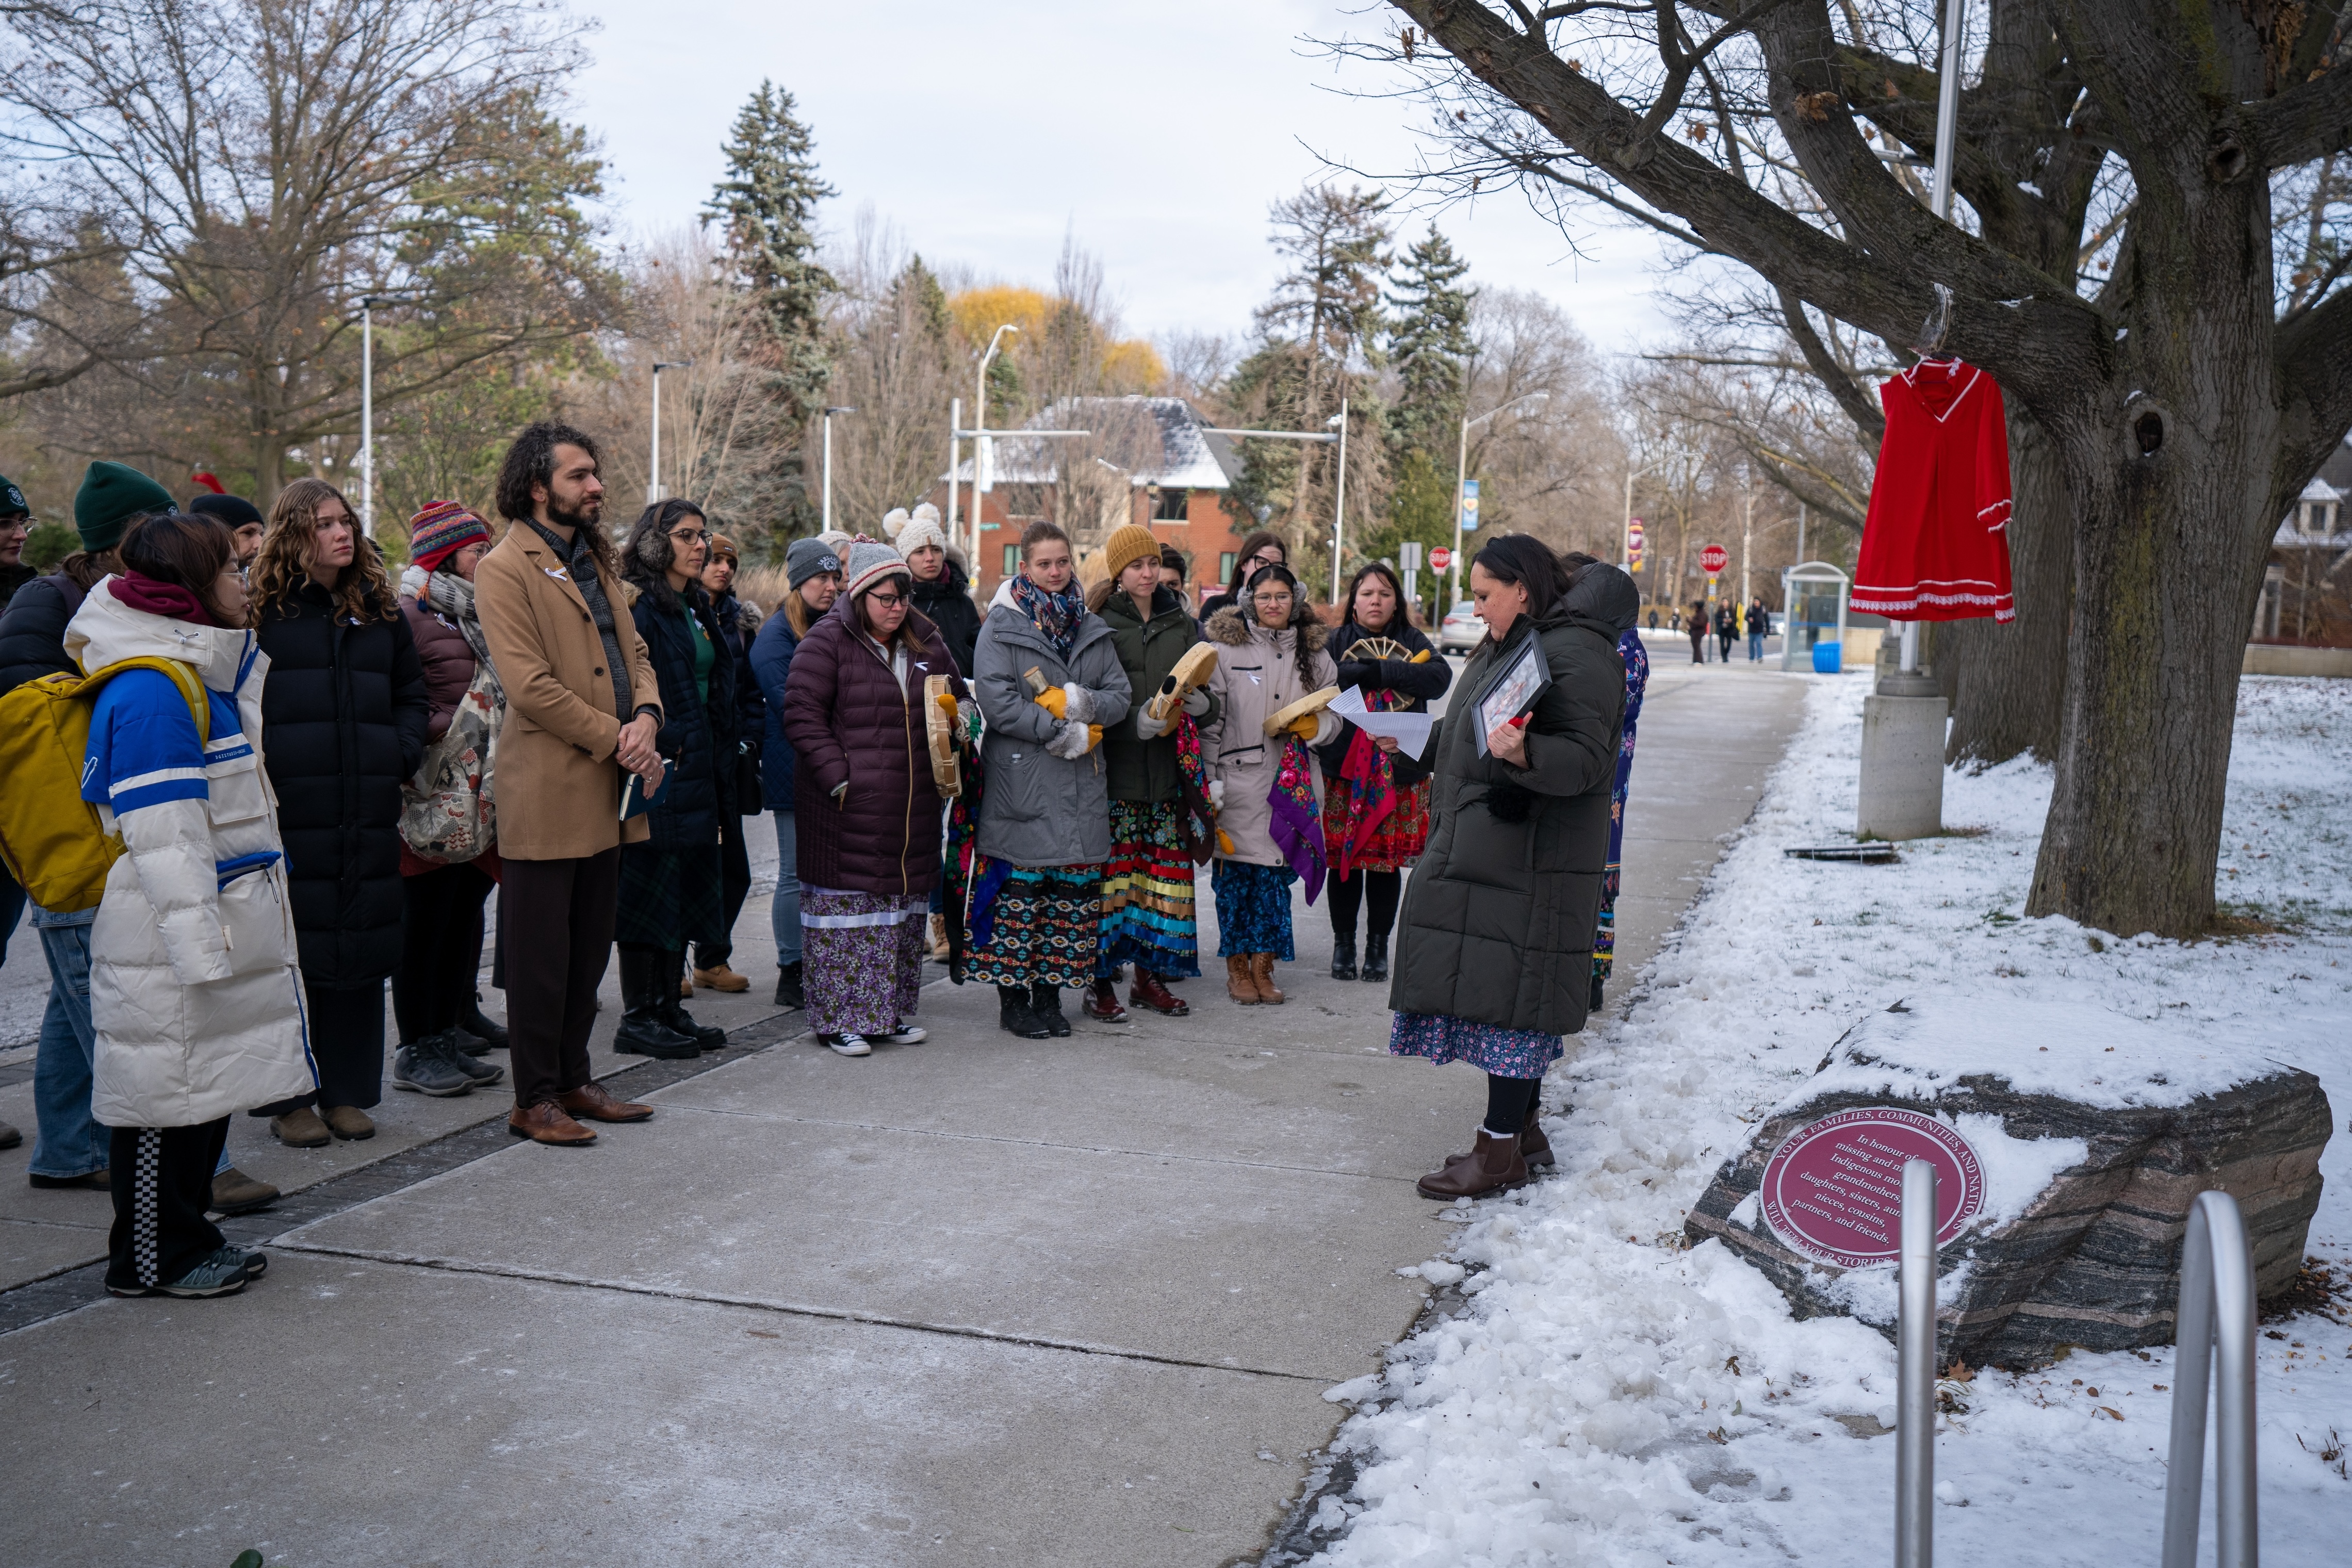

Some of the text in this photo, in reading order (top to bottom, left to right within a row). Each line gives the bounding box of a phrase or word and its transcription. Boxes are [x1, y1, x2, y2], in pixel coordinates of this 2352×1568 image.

[1430, 552, 1450, 562] STOP
[1701, 552, 1726, 565] STOP
[1776, 1131, 1809, 1160] YOUR
[1809, 1110, 1874, 1134] FAMILIES,
[1878, 1110, 1962, 1152] COMMUNITIES,
[1958, 1150, 1977, 1173] AND
[1835, 1142, 1894, 1168] missing and
[1856, 1134, 1869, 1145] In
[1869, 1139, 1904, 1157] honour
[1830, 1153, 1883, 1179] Indigenous
[1800, 1171, 1847, 1197] daughters,
[1849, 1191, 1881, 1211] sisters,
[1832, 1171, 1901, 1204] grandmothers,
[1790, 1198, 1889, 1244] partners, and friends.
[1814, 1192, 1885, 1228] nieces, cousins,
[1766, 1200, 1780, 1228] WILL
[1804, 1243, 1835, 1260] YOUR
